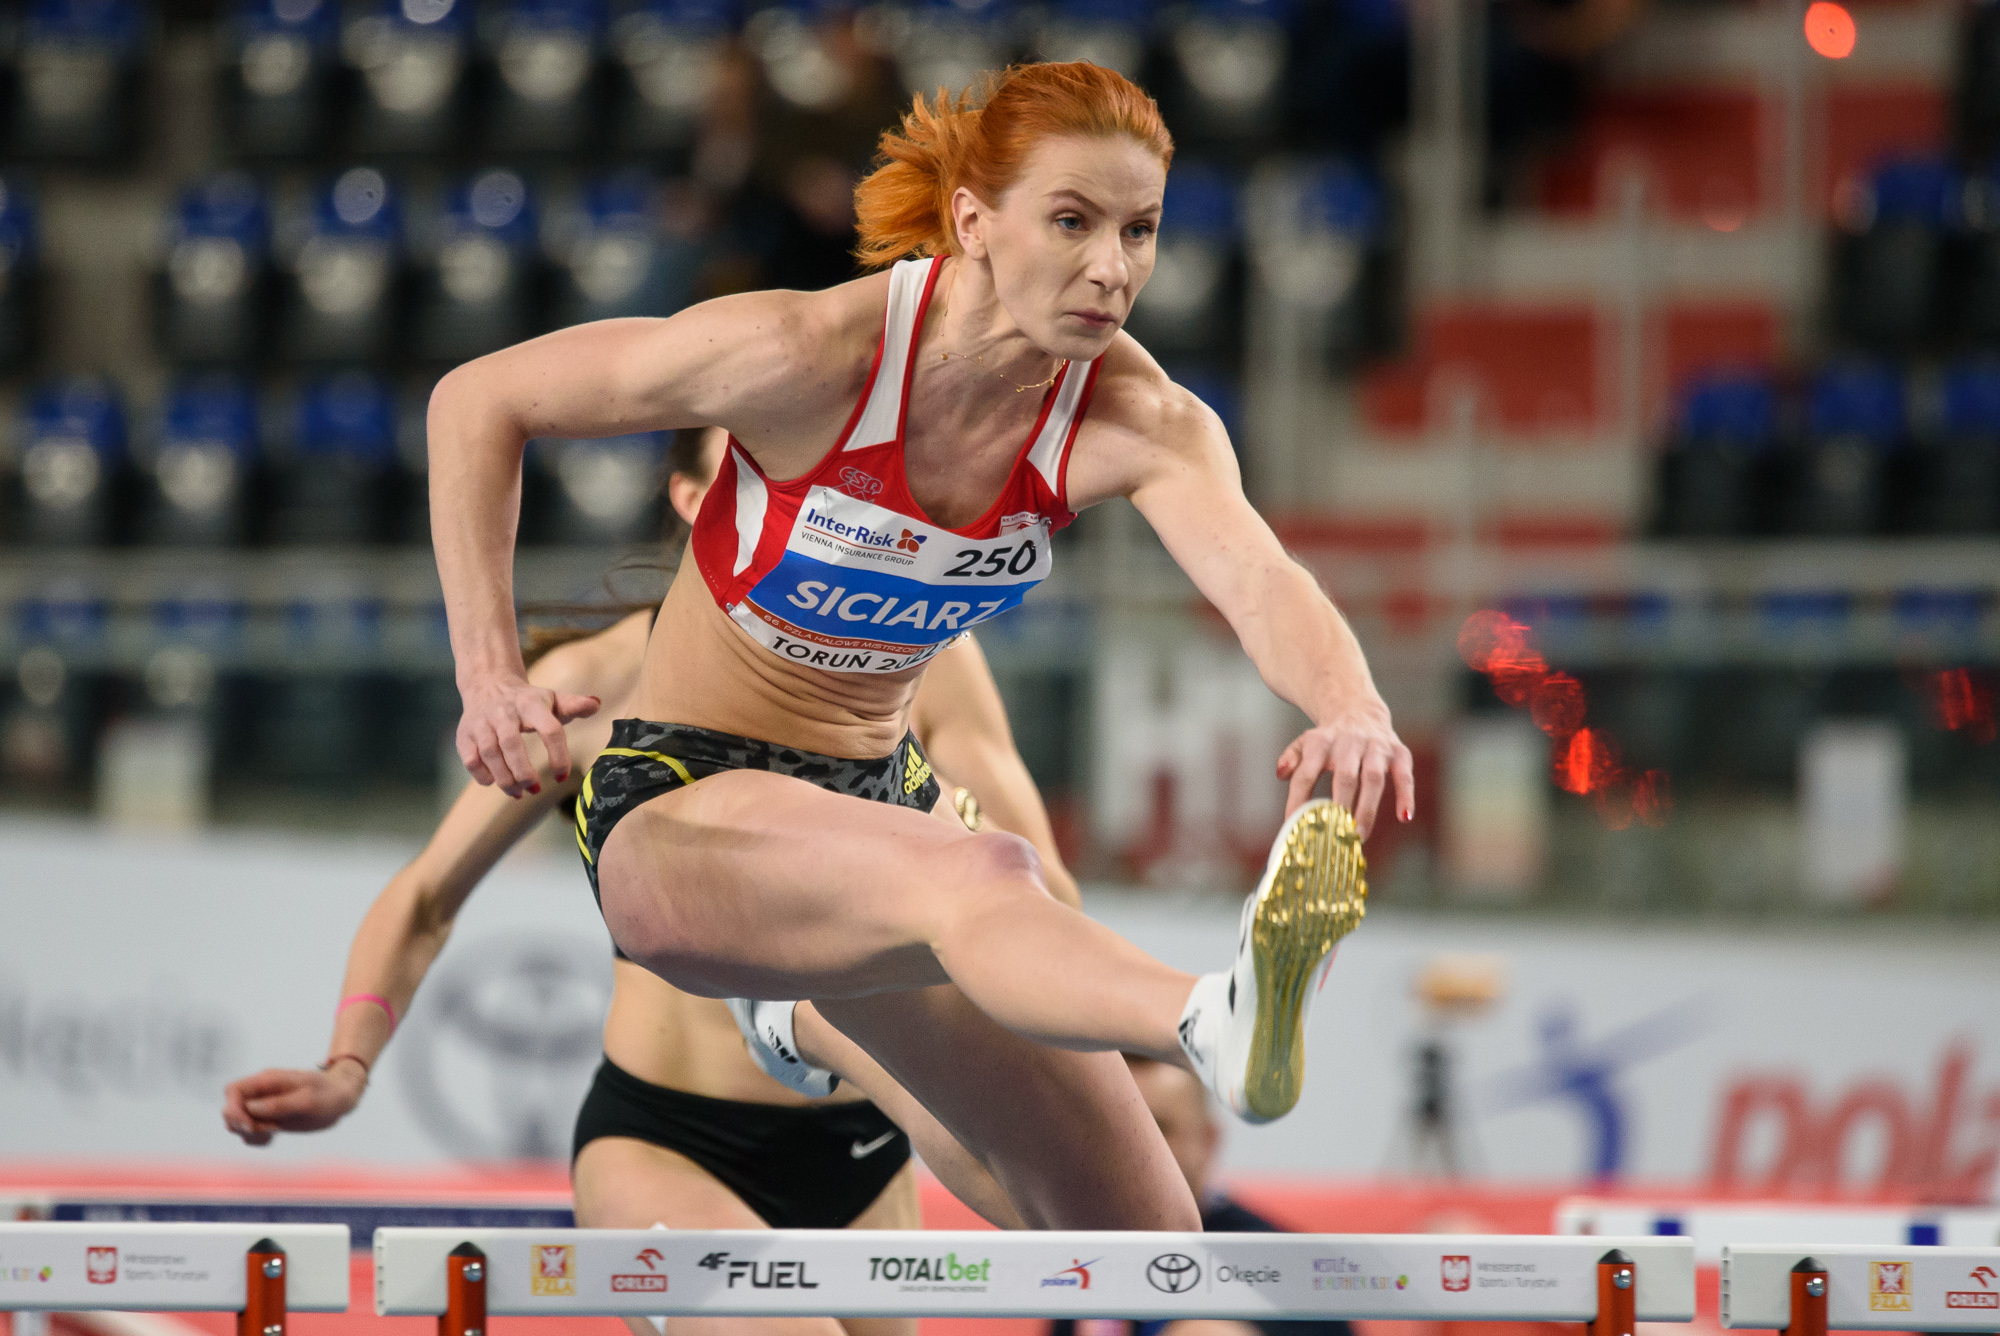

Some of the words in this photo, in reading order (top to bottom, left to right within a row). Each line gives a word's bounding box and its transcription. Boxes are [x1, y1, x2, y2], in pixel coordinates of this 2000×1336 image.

[806, 508, 895, 548] InterRisk
[801, 531, 833, 549] VIENNA
[834, 544, 882, 561] INSURANCE
[884, 555, 914, 566] GROUP
[943, 540, 1036, 577] 250
[786, 580, 1007, 630] SICIARZ
[772, 635, 873, 669] TORUŃ
[783, 625, 812, 640] PZLA
[814, 635, 861, 648] HALOWE
[861, 641, 921, 655] MISTRZOS
[904, 761, 932, 795] adidas
[728, 1261, 819, 1288] FUEL
[869, 1252, 991, 1281] TOTALbet
[1216, 1265, 1281, 1287] Okęcie
[615, 1277, 664, 1290] ORLEN
[1948, 1294, 1996, 1307] ORLEN
